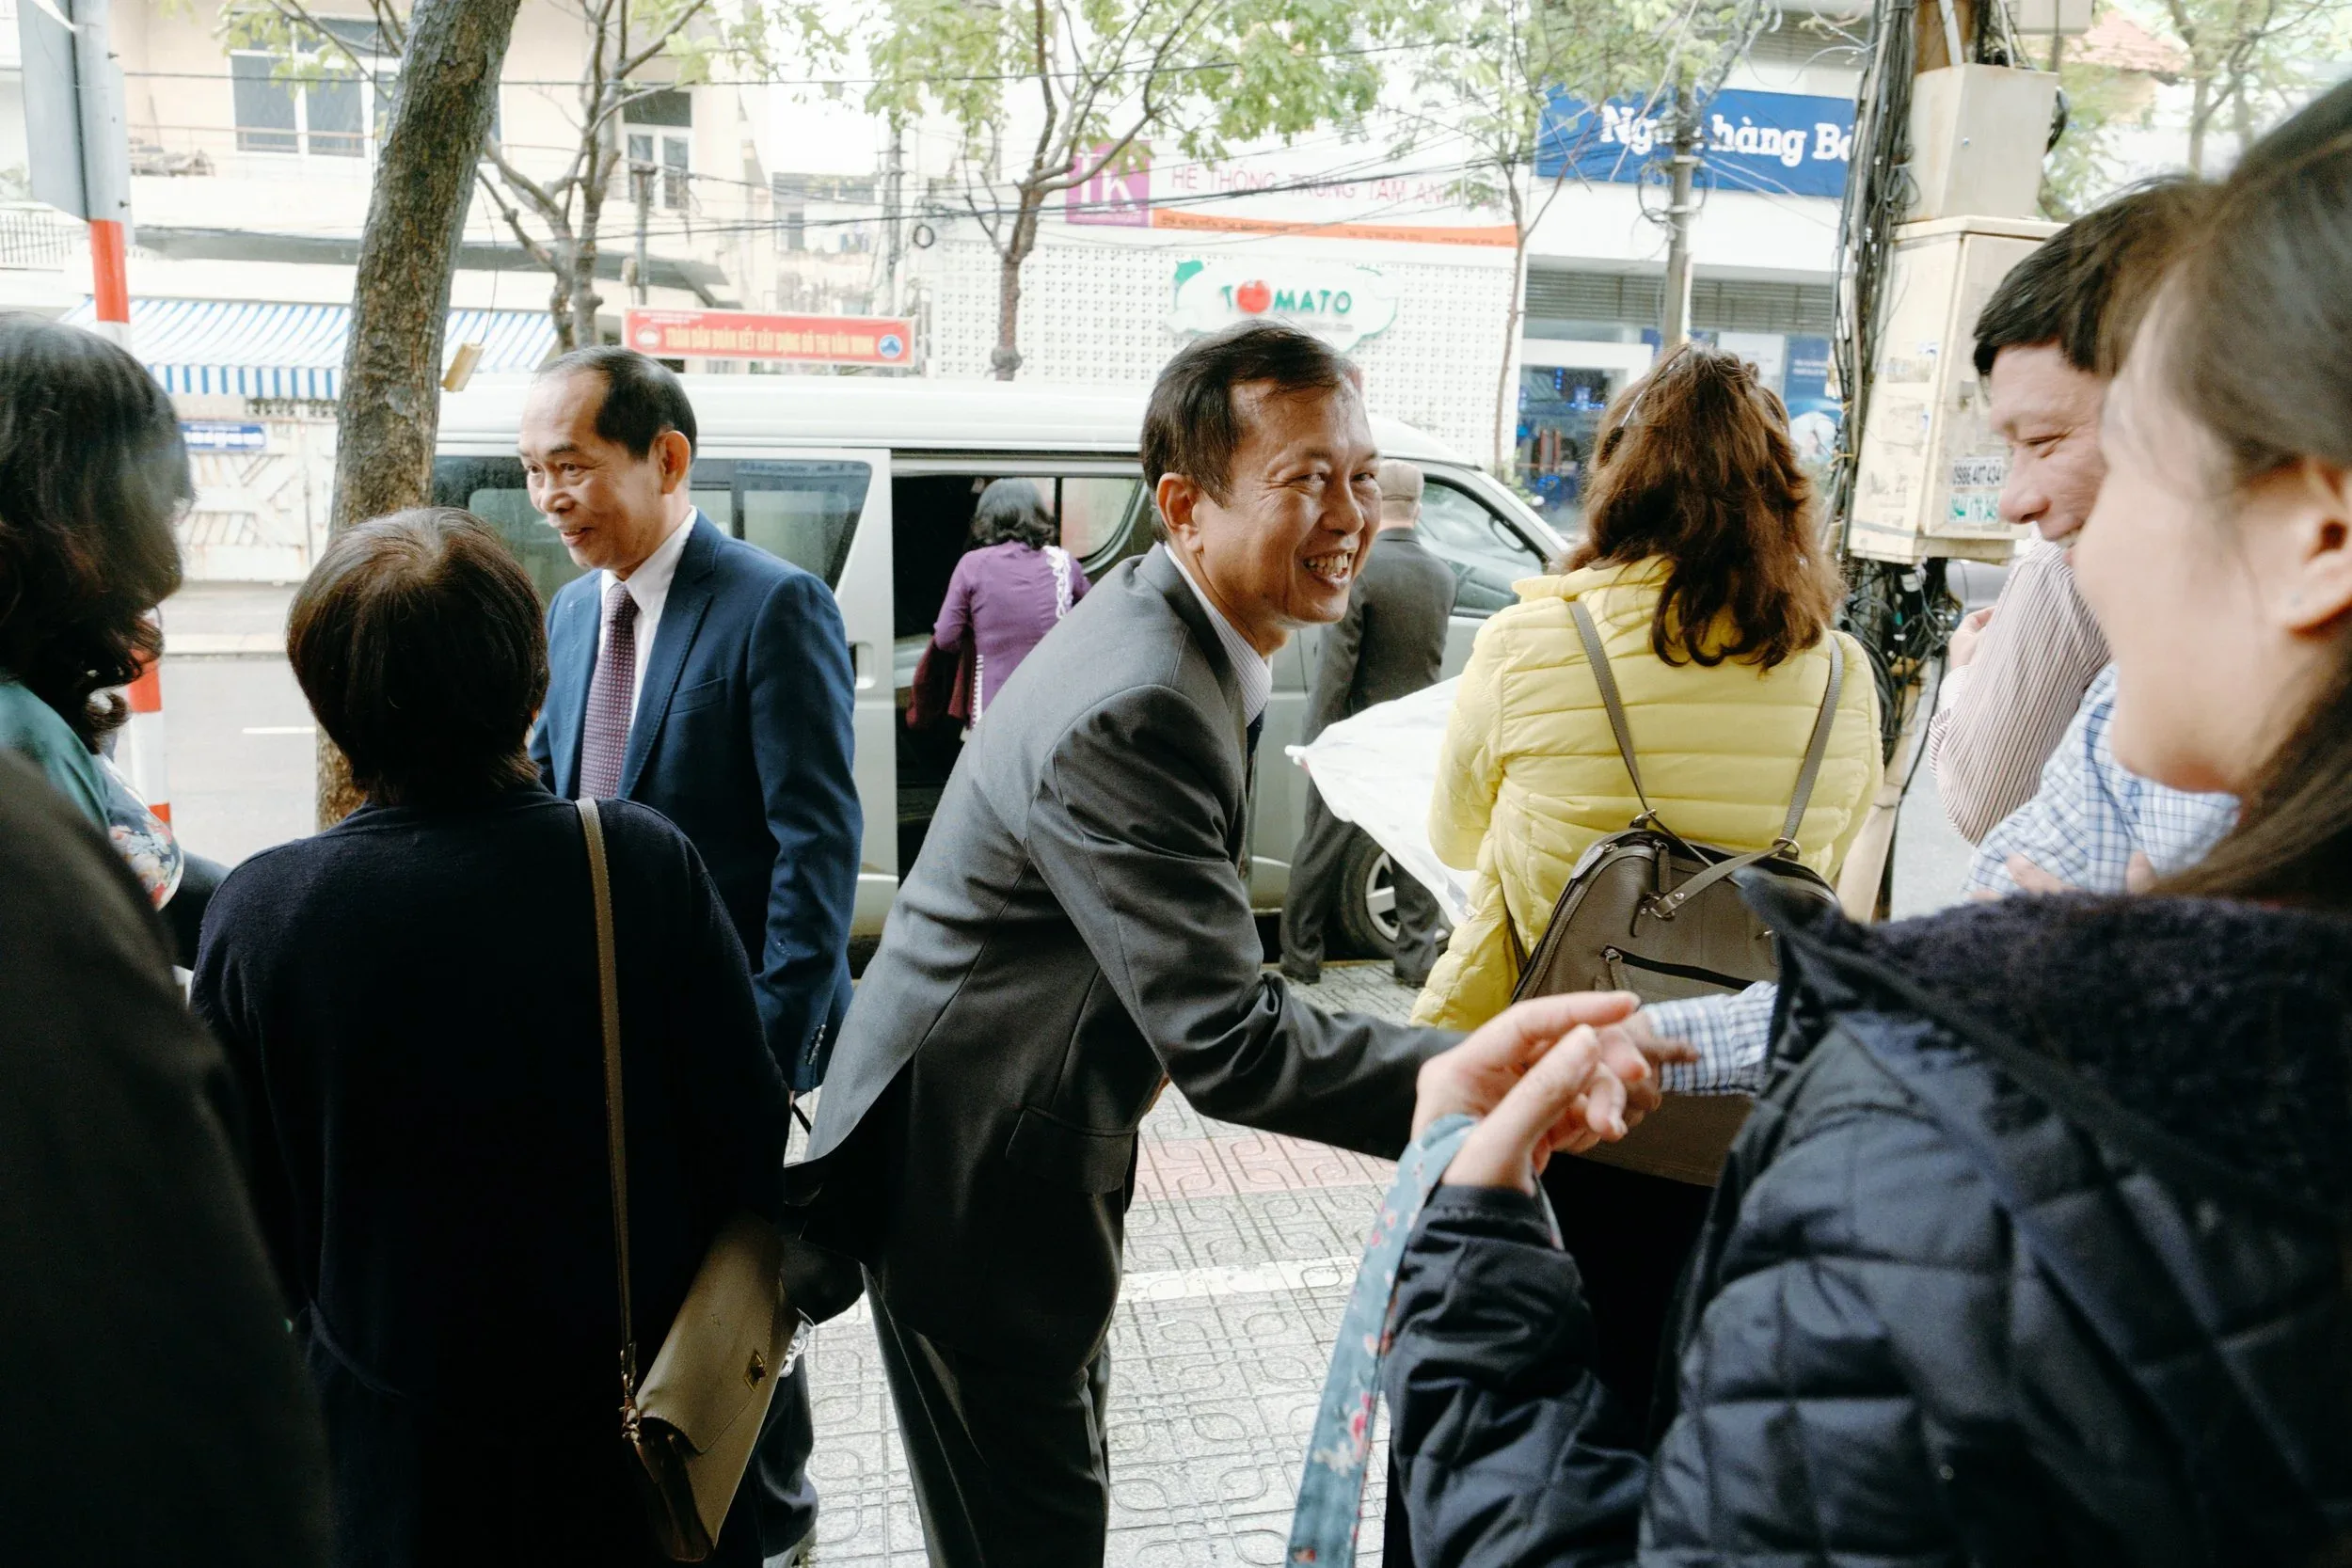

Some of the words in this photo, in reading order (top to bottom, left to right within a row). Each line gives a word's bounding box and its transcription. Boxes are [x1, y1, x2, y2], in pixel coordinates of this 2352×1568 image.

[1600, 105, 1704, 155] Ng
[1708, 113, 1807, 167] hàng
[1220, 280, 1352, 314] TOMATO
